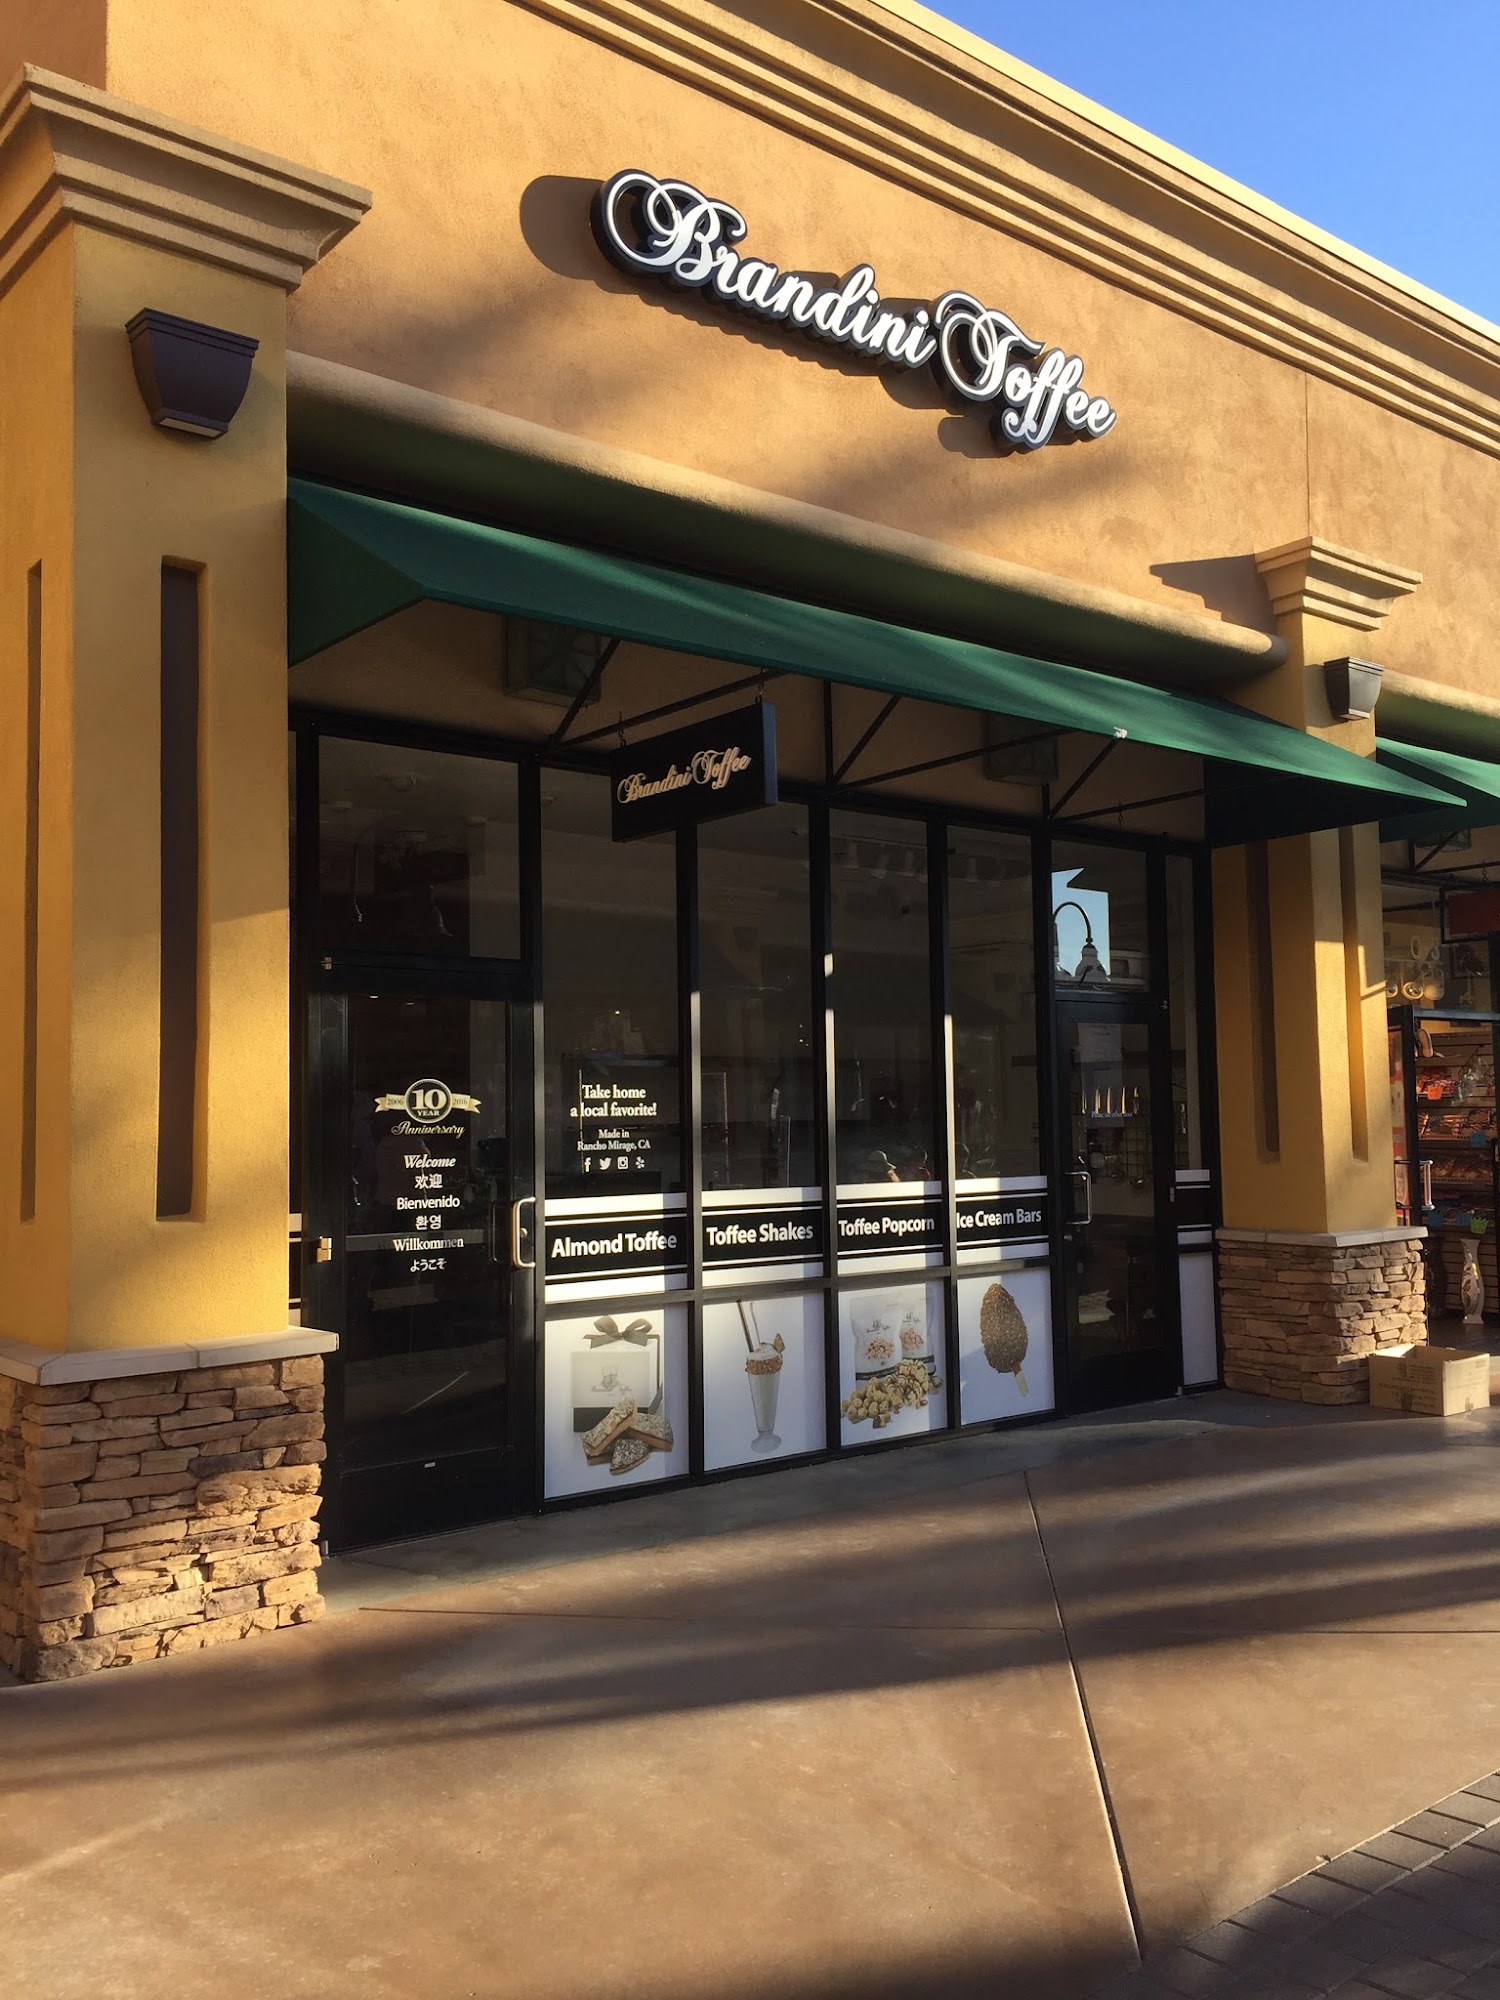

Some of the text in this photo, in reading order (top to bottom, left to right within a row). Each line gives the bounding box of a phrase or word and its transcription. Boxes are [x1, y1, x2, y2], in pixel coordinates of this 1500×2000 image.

[596, 168, 1117, 449] Brandini Toffee
[617, 746, 752, 804] Brandini Toffee
[411, 1088, 447, 1110] 10
[582, 1083, 646, 1099] Take home
[570, 1101, 657, 1117] a local favorite!
[391, 1120, 465, 1139] Anniversary
[598, 1128, 630, 1139] Made in
[577, 1139, 651, 1152] Rancho Mirage, CA
[403, 1153, 456, 1169] Welcome
[414, 1173, 443, 1189] 欢迎
[396, 1194, 460, 1211] Bienvenido
[415, 1214, 441, 1230] 환영
[838, 1216, 935, 1237] Toffee Popcorn
[956, 1208, 1042, 1229] Ice Cream Bars
[706, 1221, 814, 1246] Toffee Shakes
[392, 1237, 464, 1252] Willkommen
[551, 1230, 678, 1259] Almond Toffee
[410, 1257, 447, 1273] ようこそ
